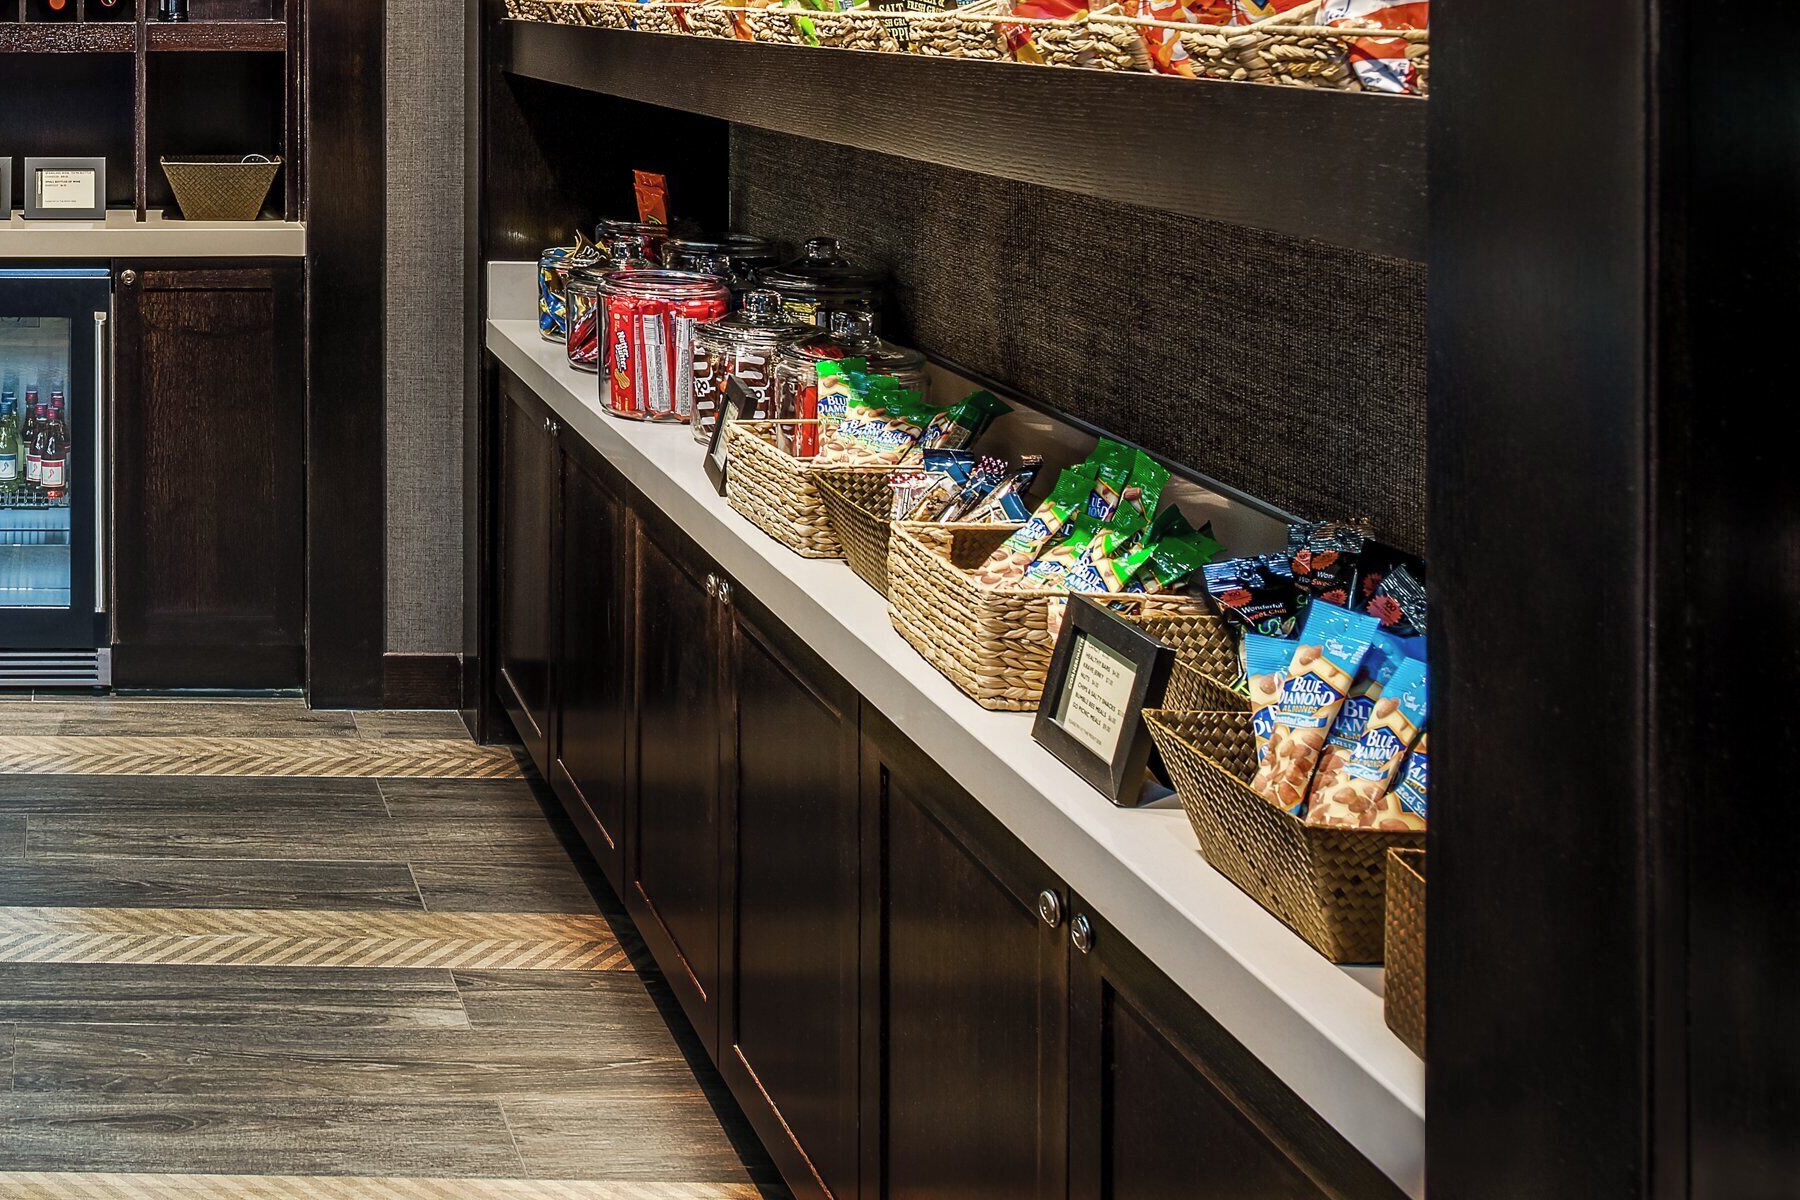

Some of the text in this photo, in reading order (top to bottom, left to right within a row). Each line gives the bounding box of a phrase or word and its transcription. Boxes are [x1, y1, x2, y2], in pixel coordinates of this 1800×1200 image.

[906, 1, 925, 12] FRESH
[817, 403, 848, 414] DIAMO
[1241, 601, 1285, 615] Wonderful
[1291, 675, 1324, 694] BLUE
[1278, 687, 1335, 707] DIAMOND
[1366, 729, 1397, 749] BLUE
[1353, 742, 1401, 761] DIAMOND
